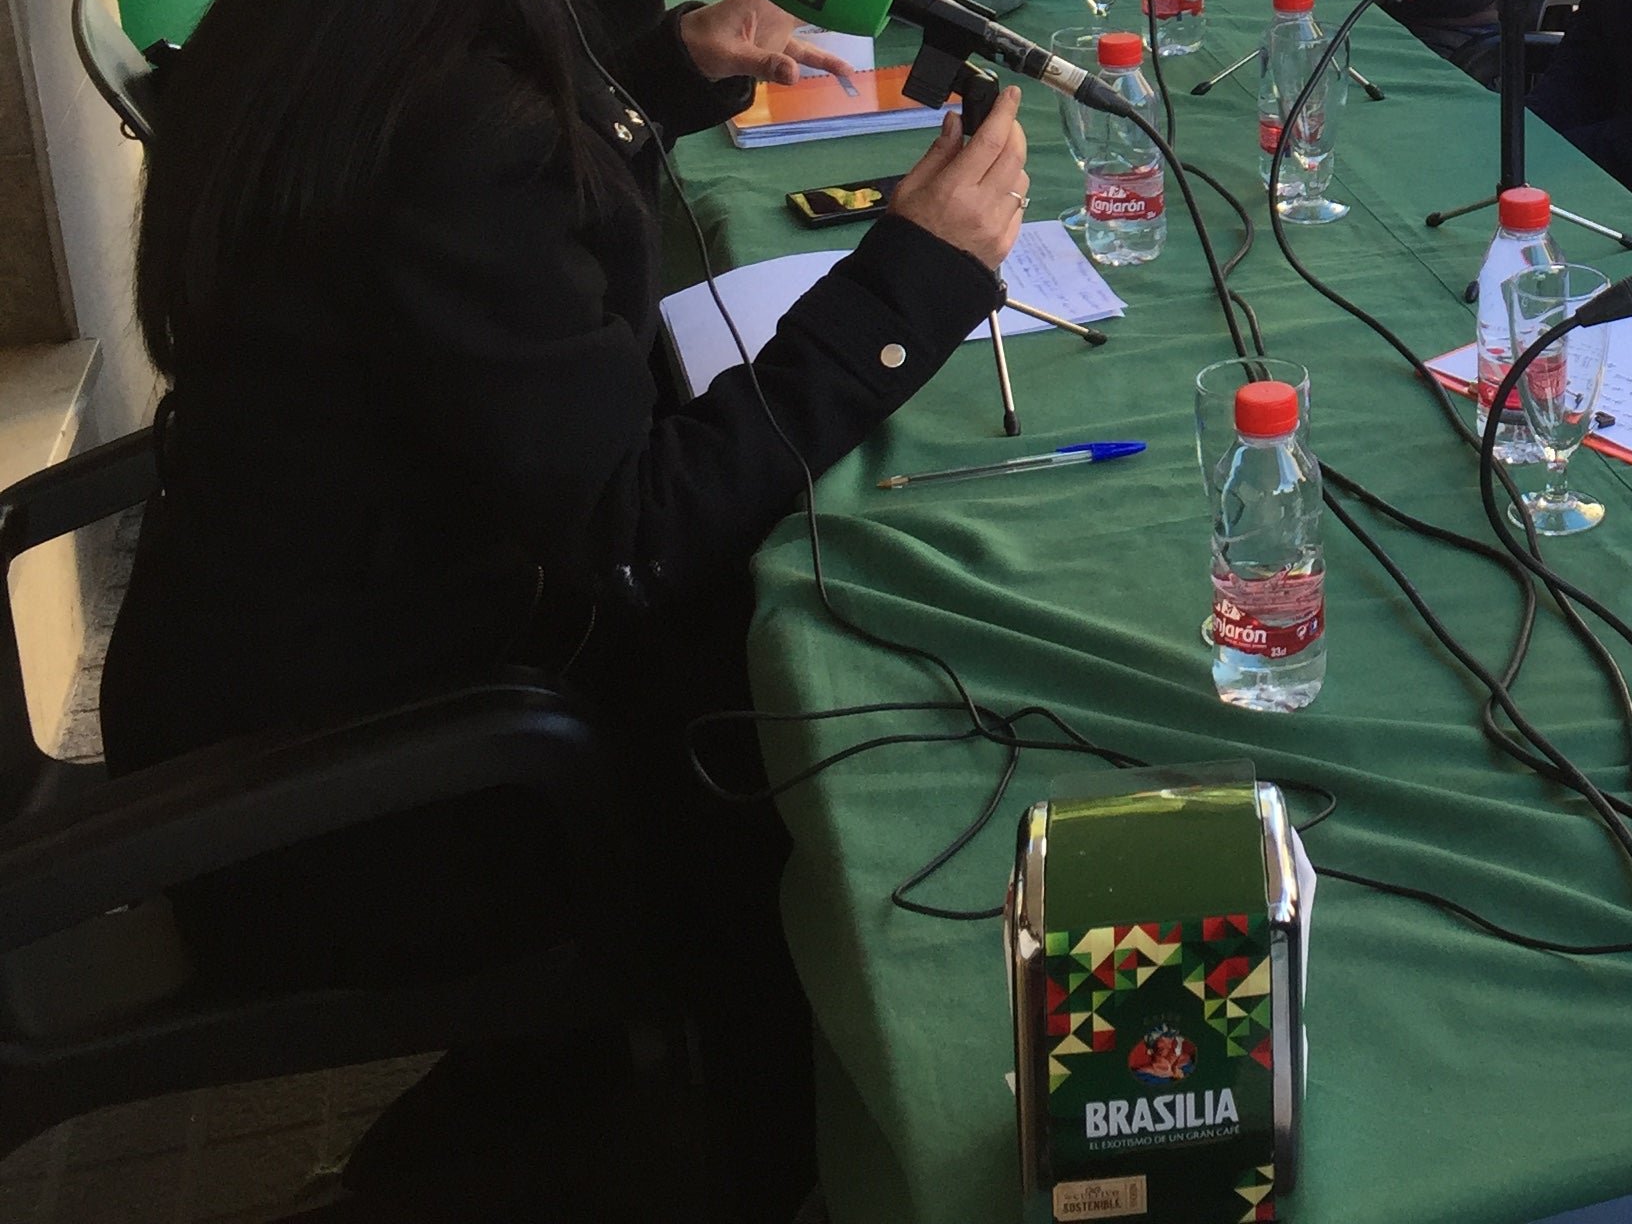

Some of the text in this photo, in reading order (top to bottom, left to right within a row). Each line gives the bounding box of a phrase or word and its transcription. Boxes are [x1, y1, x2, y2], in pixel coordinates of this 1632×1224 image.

[1091, 195, 1146, 214] Lanjarón
[1212, 614, 1267, 644] njarón
[1085, 1087, 1240, 1138] BRASILIA
[1089, 1141, 1100, 1151] EL
[1101, 1137, 1153, 1150] EXOTISMO
[1154, 1135, 1166, 1144] DE
[1168, 1133, 1184, 1142] UN
[1185, 1129, 1215, 1140] GRAN
[1062, 1198, 1121, 1214] SOSTENIBLE
